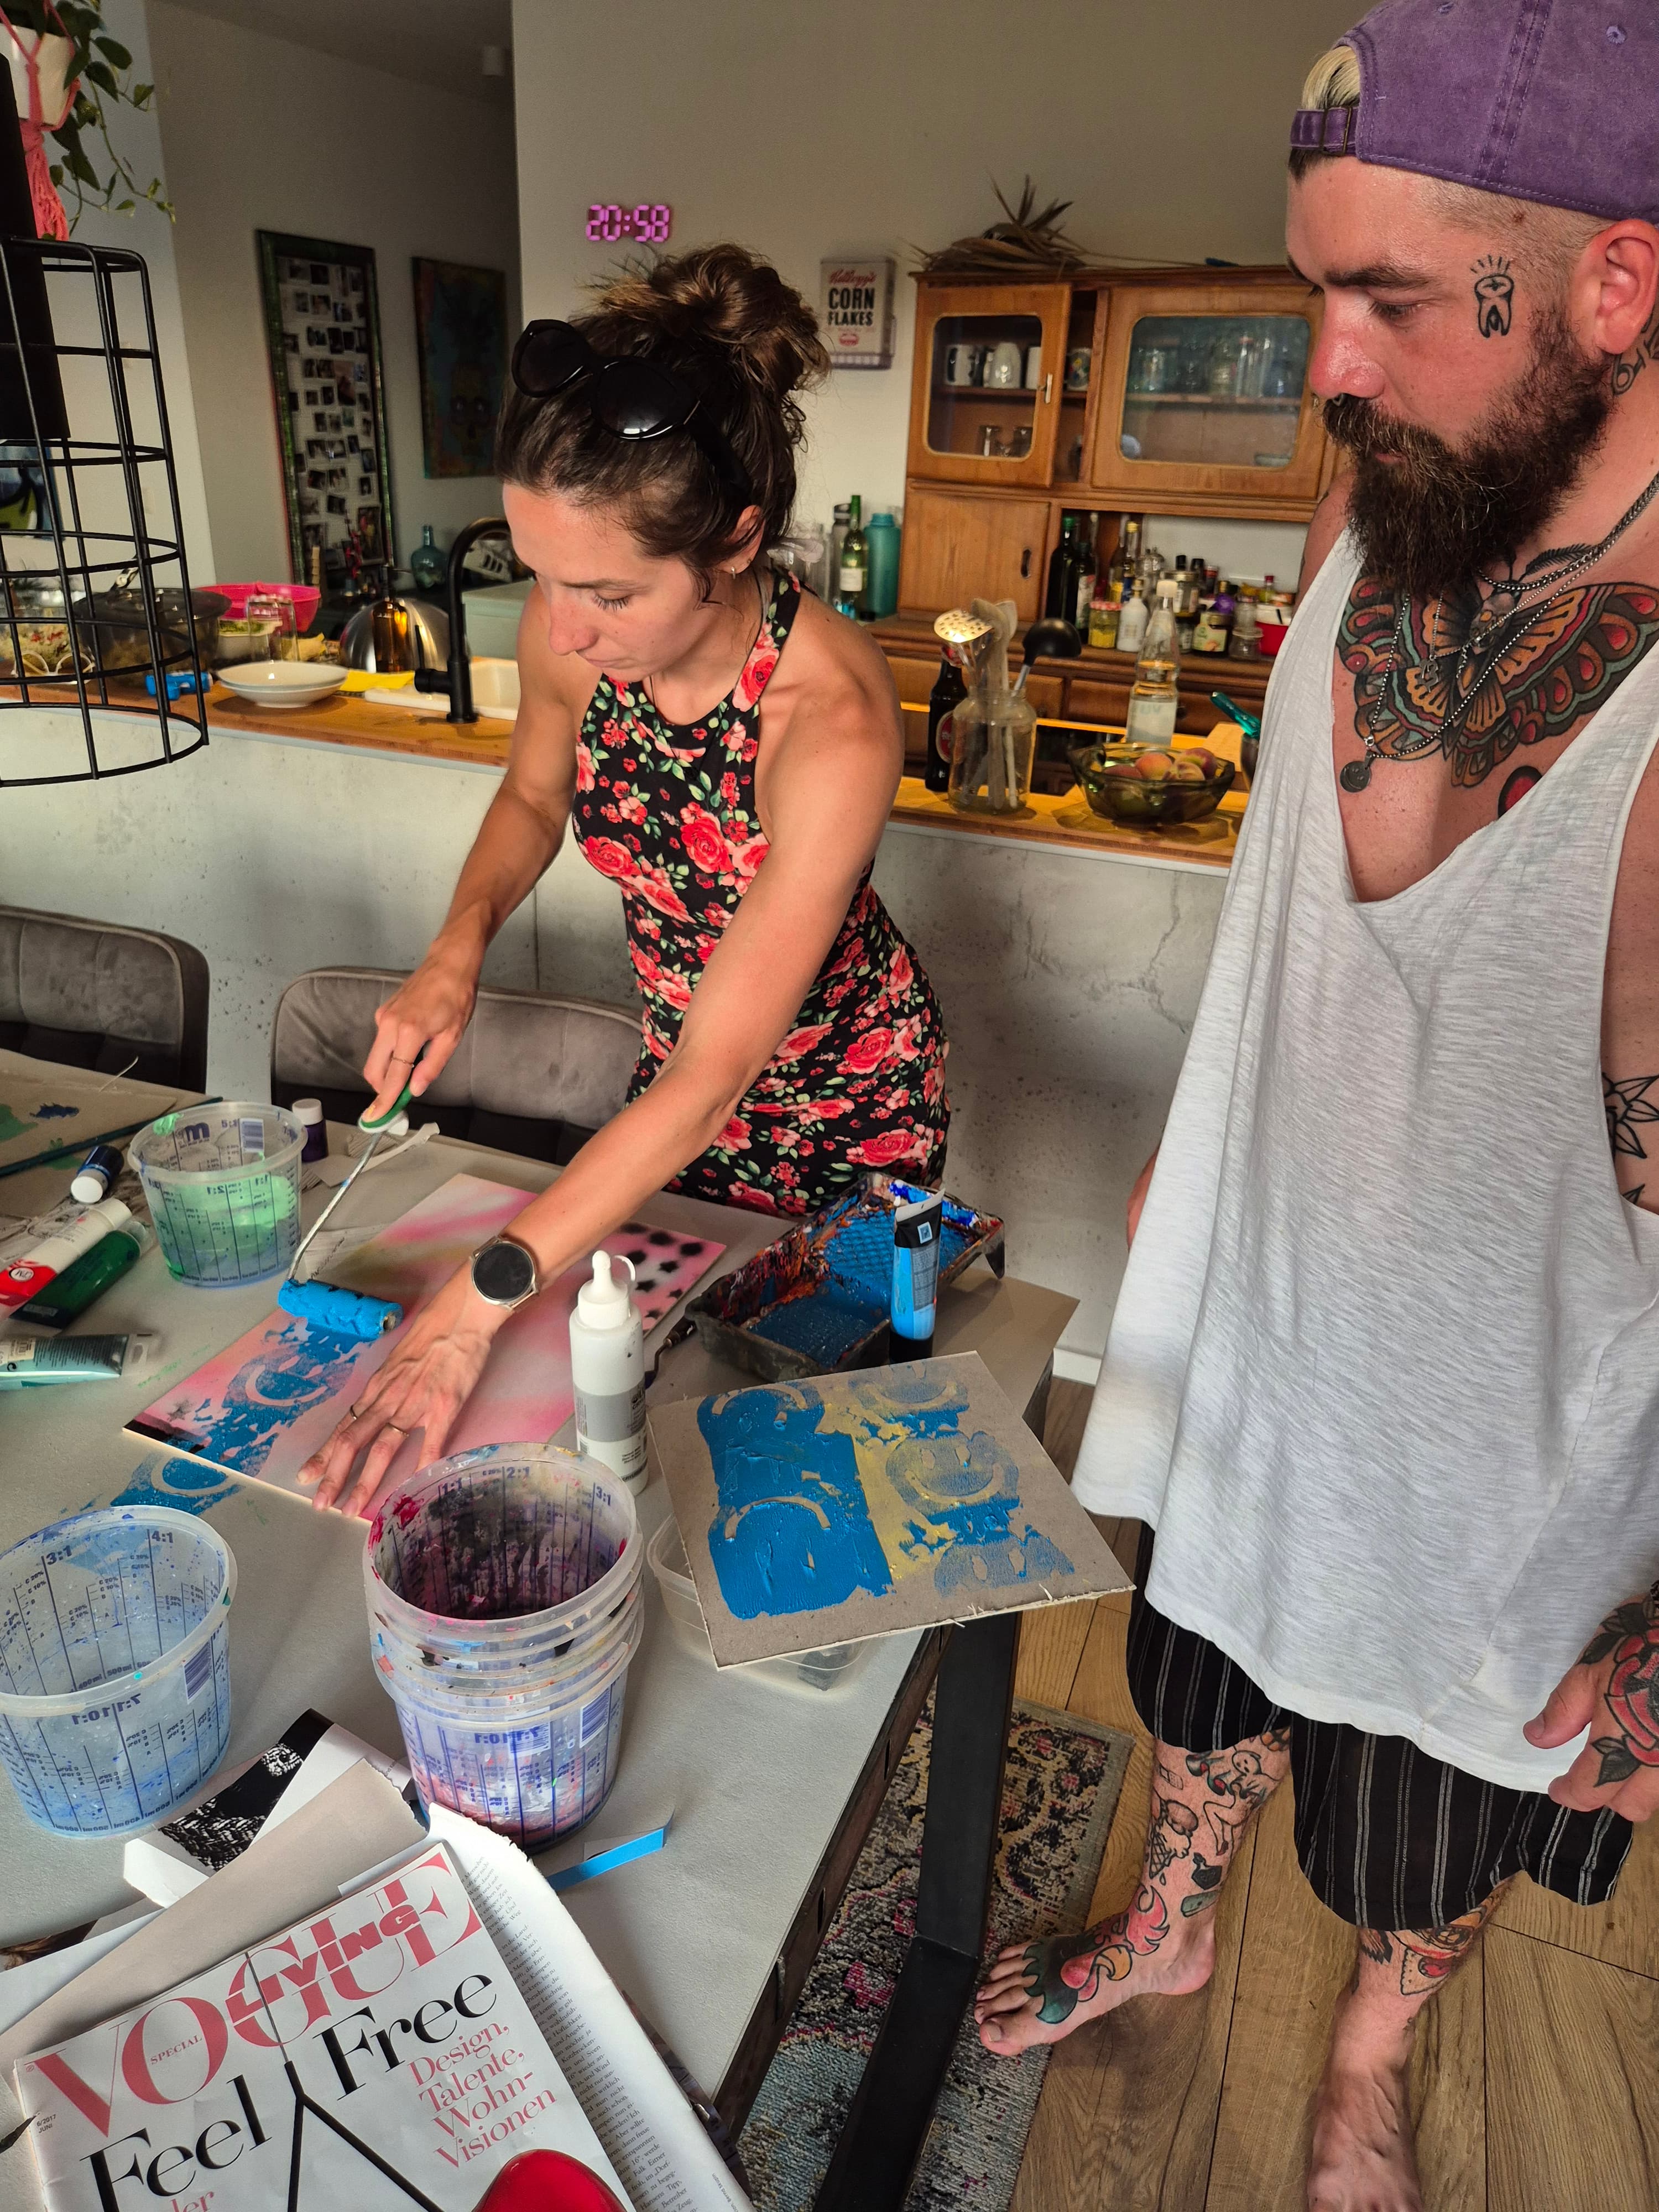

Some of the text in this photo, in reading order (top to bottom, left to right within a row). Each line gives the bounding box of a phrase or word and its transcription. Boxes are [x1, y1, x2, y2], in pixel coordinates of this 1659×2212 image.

[586, 204, 670, 242] 20:58
[828, 287, 875, 310] CORN
[828, 311, 874, 327] FLAKES
[507, 1466, 530, 1479] 2:1
[596, 1486, 611, 1506] 3:1
[152, 1530, 174, 1543] 4:1
[46, 1545, 73, 1566] 3:1
[23, 1851, 483, 2137] VOGUE
[150, 2034, 203, 2067] SPECIAL
[406, 2022, 510, 2088] Design,
[80, 1974, 497, 2212] Feel Free
[419, 2048, 525, 2114] Talente,
[431, 2071, 534, 2138] Wohn-
[36, 2114, 56, 2126] 6/2017
[38, 2124, 53, 2133] JUNI
[433, 2089, 557, 2168] Visionen
